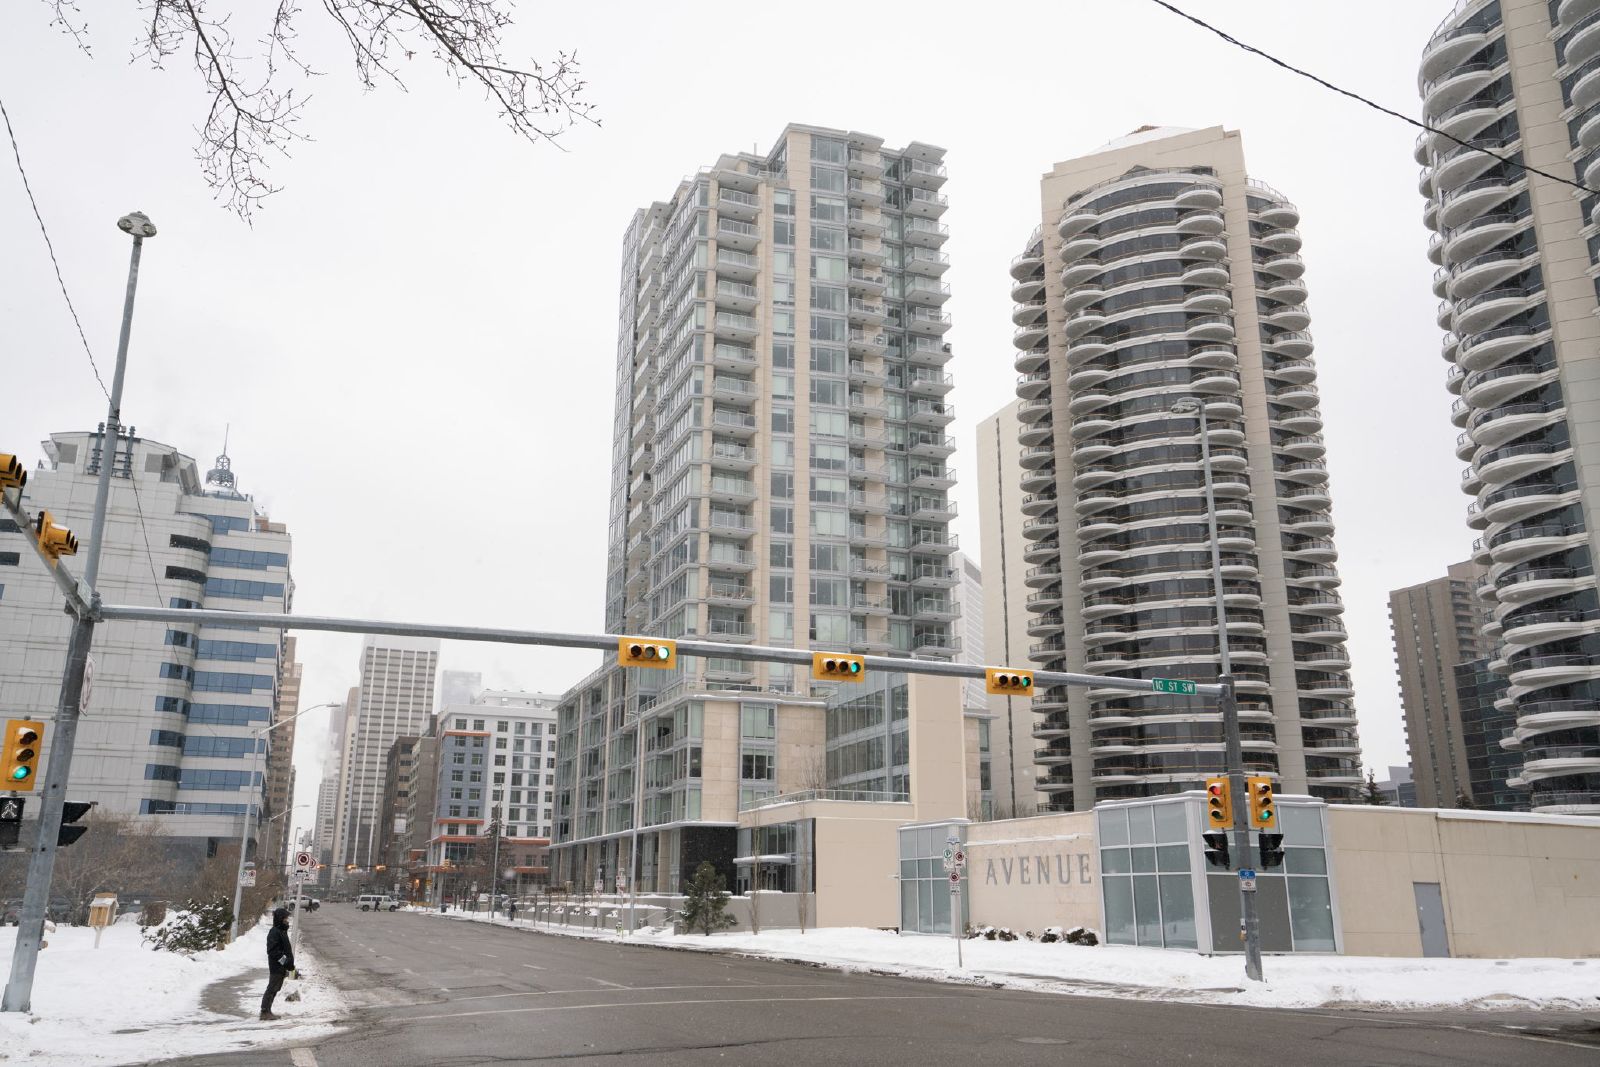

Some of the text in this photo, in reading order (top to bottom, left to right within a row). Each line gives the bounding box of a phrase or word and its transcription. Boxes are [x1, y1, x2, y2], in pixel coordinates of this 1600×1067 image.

[1155, 680, 1193, 692] 10 ST SW
[985, 853, 1092, 886] AVENUE
